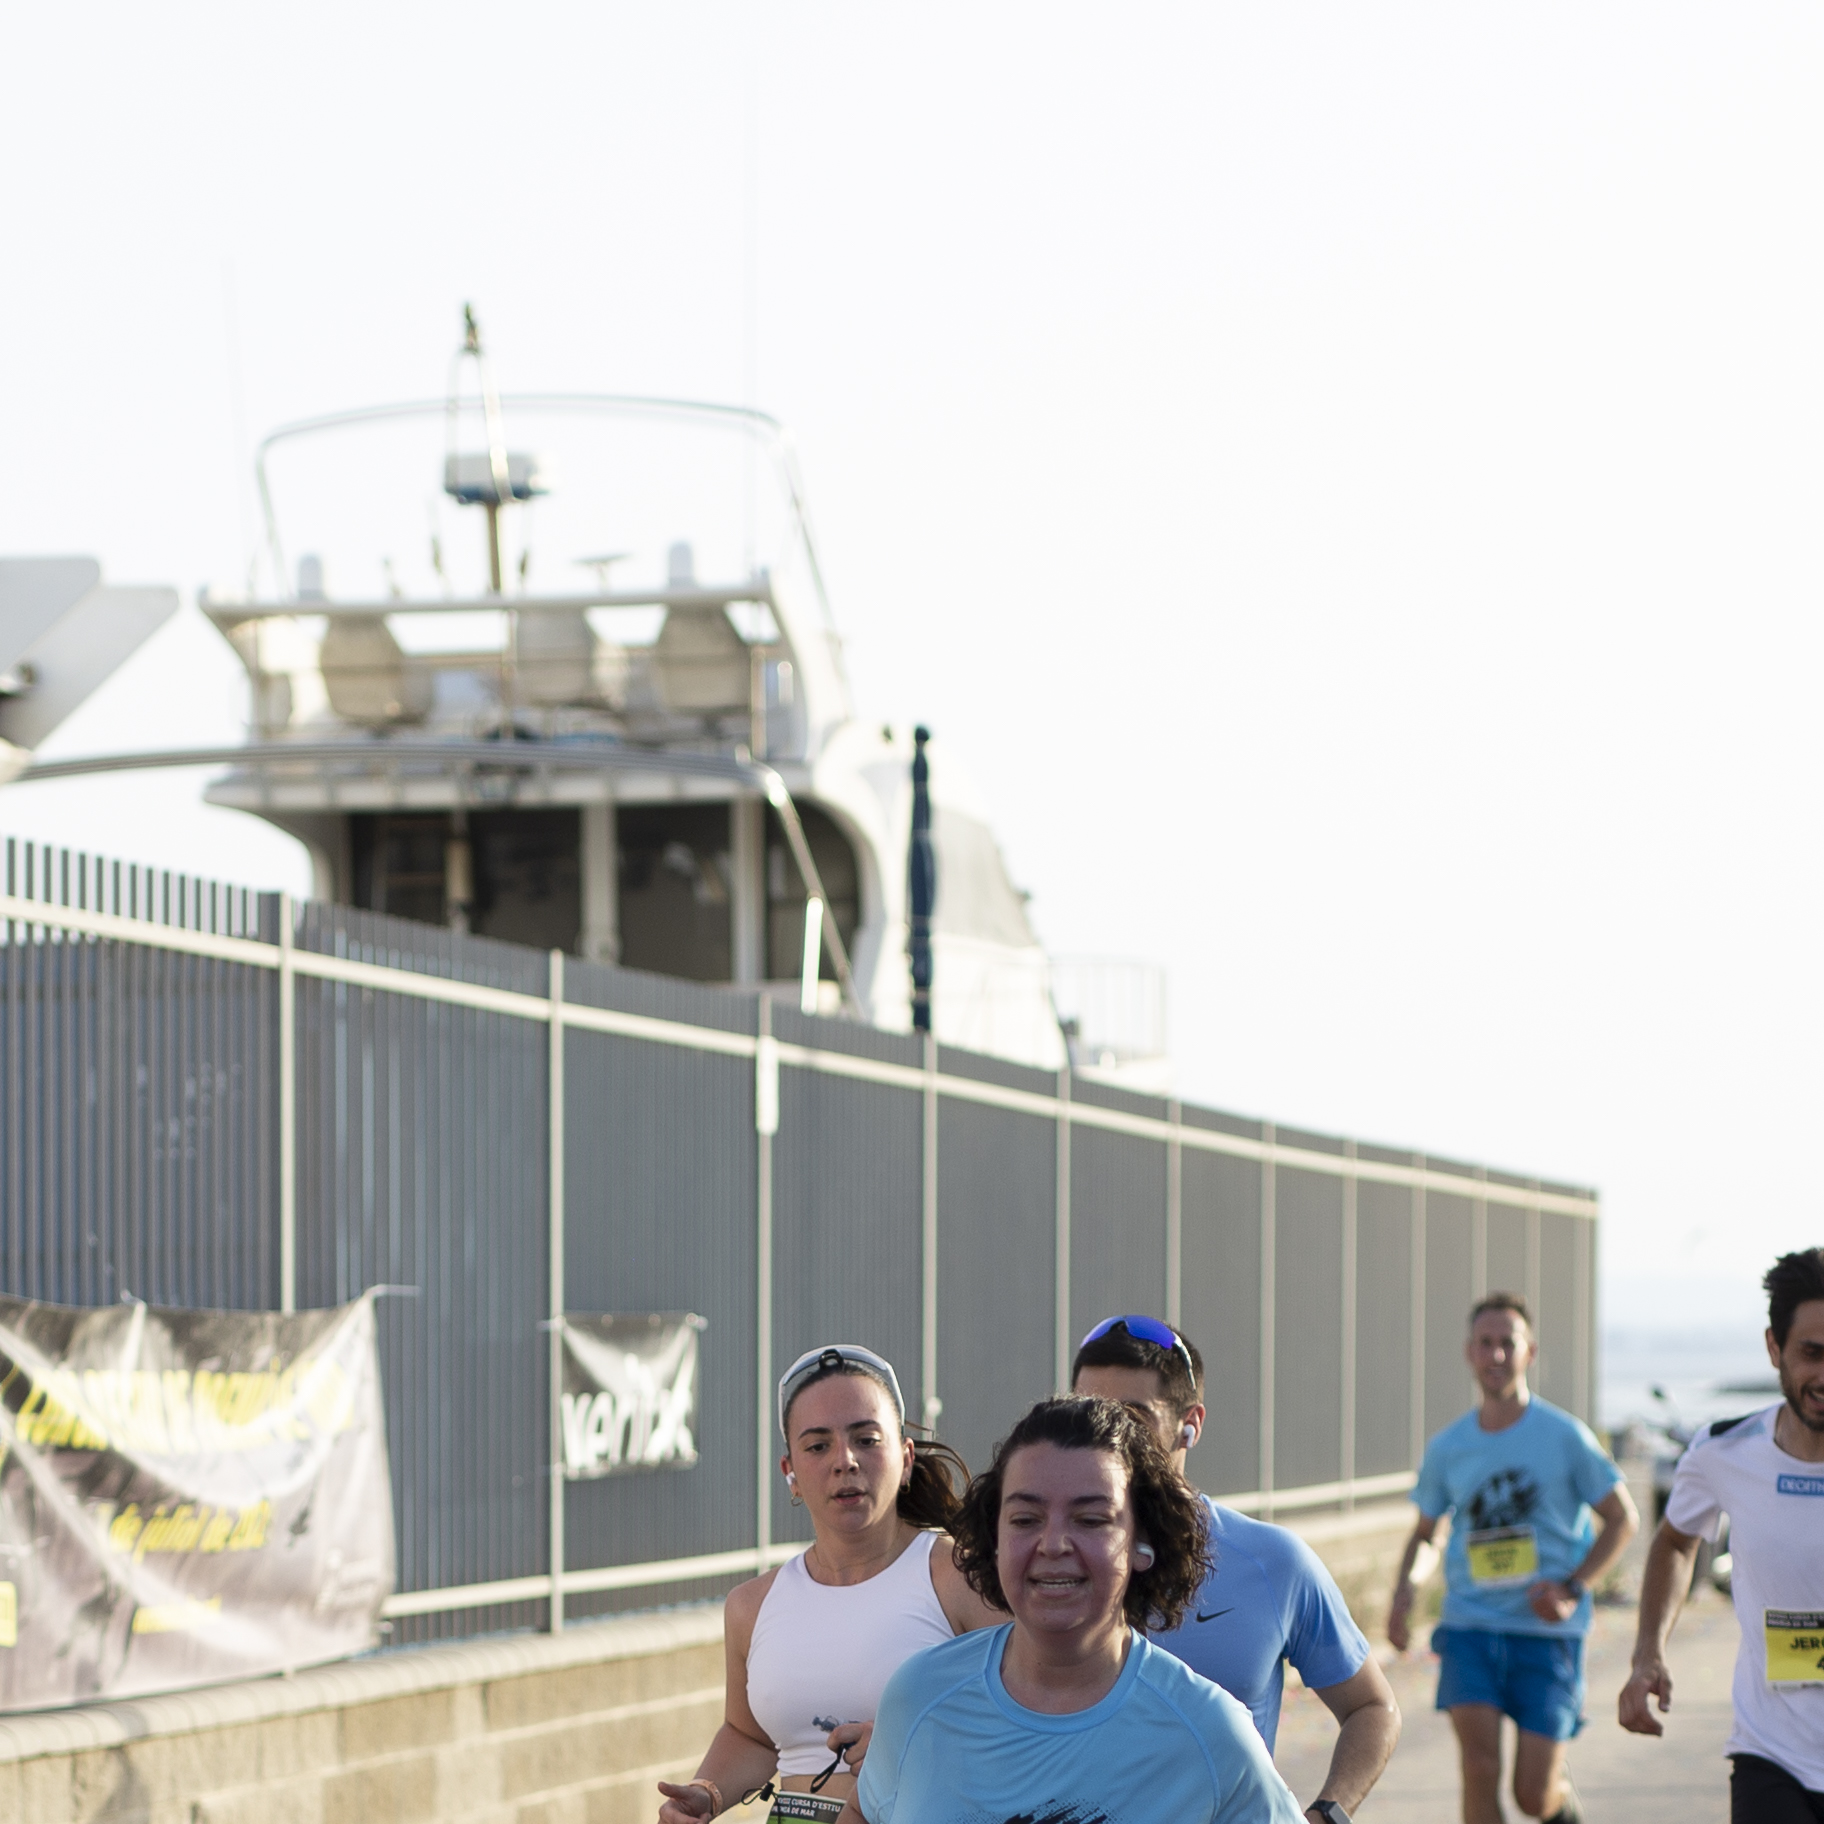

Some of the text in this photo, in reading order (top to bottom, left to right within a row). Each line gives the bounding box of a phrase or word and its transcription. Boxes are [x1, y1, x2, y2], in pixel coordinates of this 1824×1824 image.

[791, 1798, 811, 1808] CURSA
[811, 1800, 842, 1813] D'ESTIU
[800, 1807, 816, 1817] MAR
